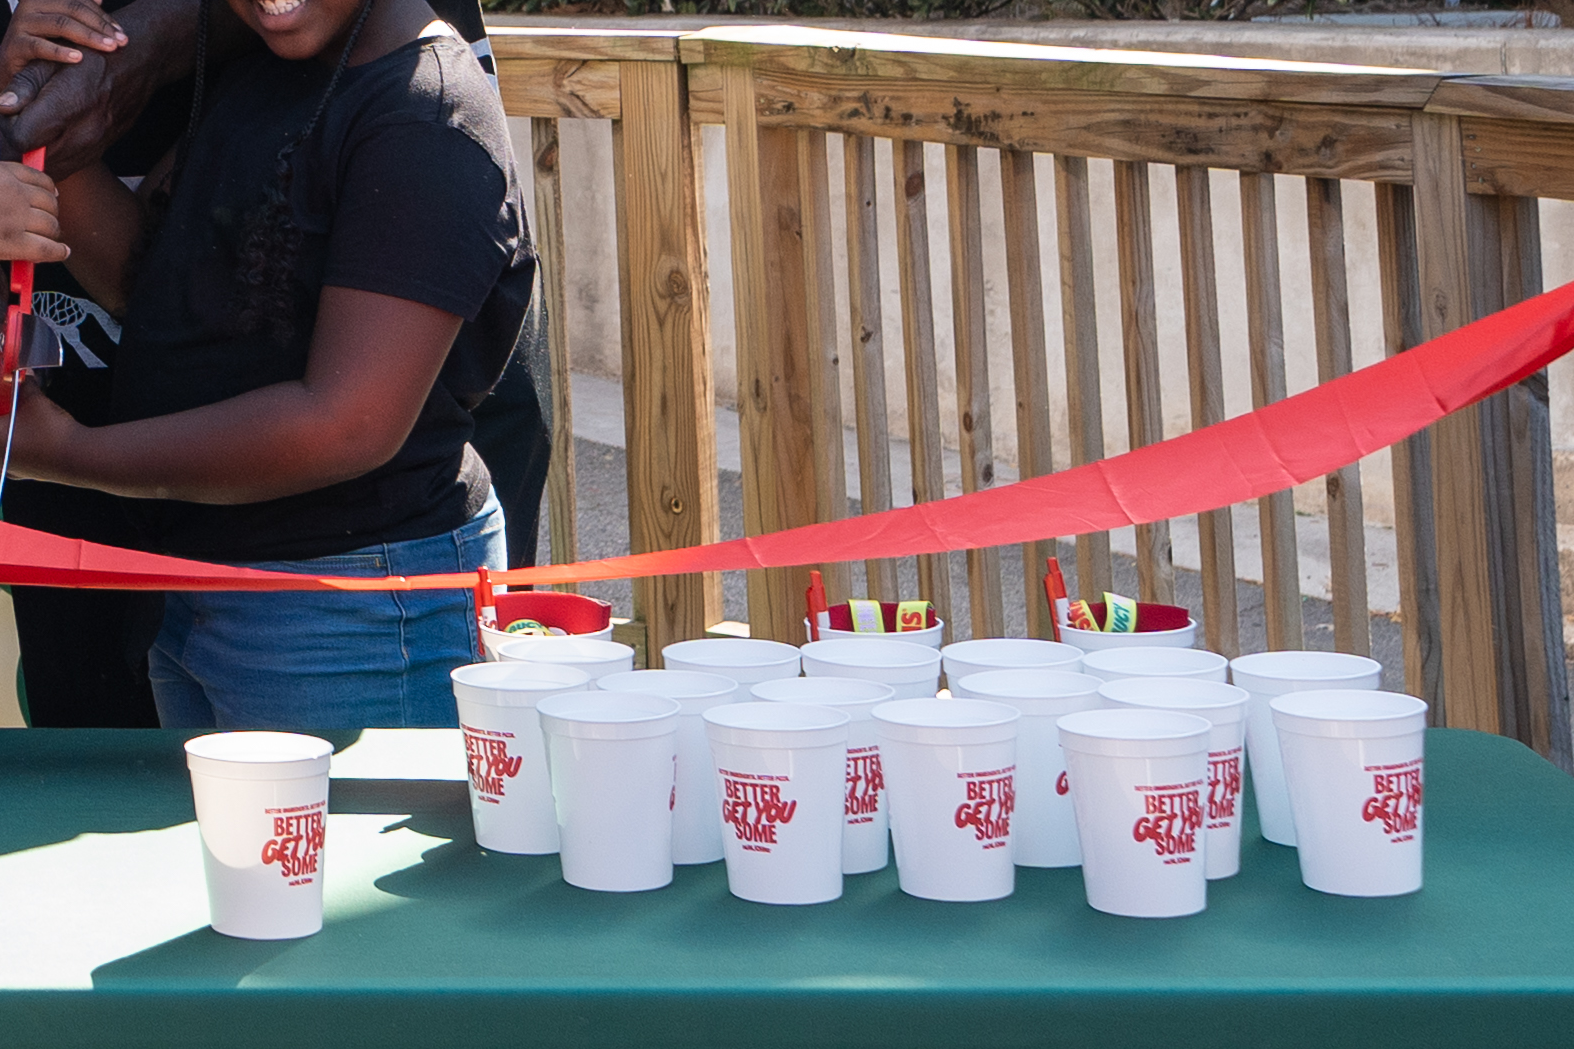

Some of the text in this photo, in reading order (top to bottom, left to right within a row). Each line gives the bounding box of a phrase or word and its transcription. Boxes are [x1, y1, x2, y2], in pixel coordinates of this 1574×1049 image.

[486, 755, 523, 778] YOU
[472, 774, 505, 797] SOME
[724, 778, 781, 803] BETTER
[722, 799, 797, 824] GET YOU
[954, 798, 996, 829] GET
[1144, 790, 1200, 815] BETTER
[1208, 798, 1235, 820] OME
[1362, 791, 1404, 822] GET
[273, 811, 322, 837] BETTER
[735, 821, 778, 844] SOME
[975, 816, 1010, 841] SOME
[1133, 813, 1178, 843] GET
[261, 834, 304, 865] GET
[1155, 832, 1196, 856] SOME
[281, 852, 318, 878] SOME
